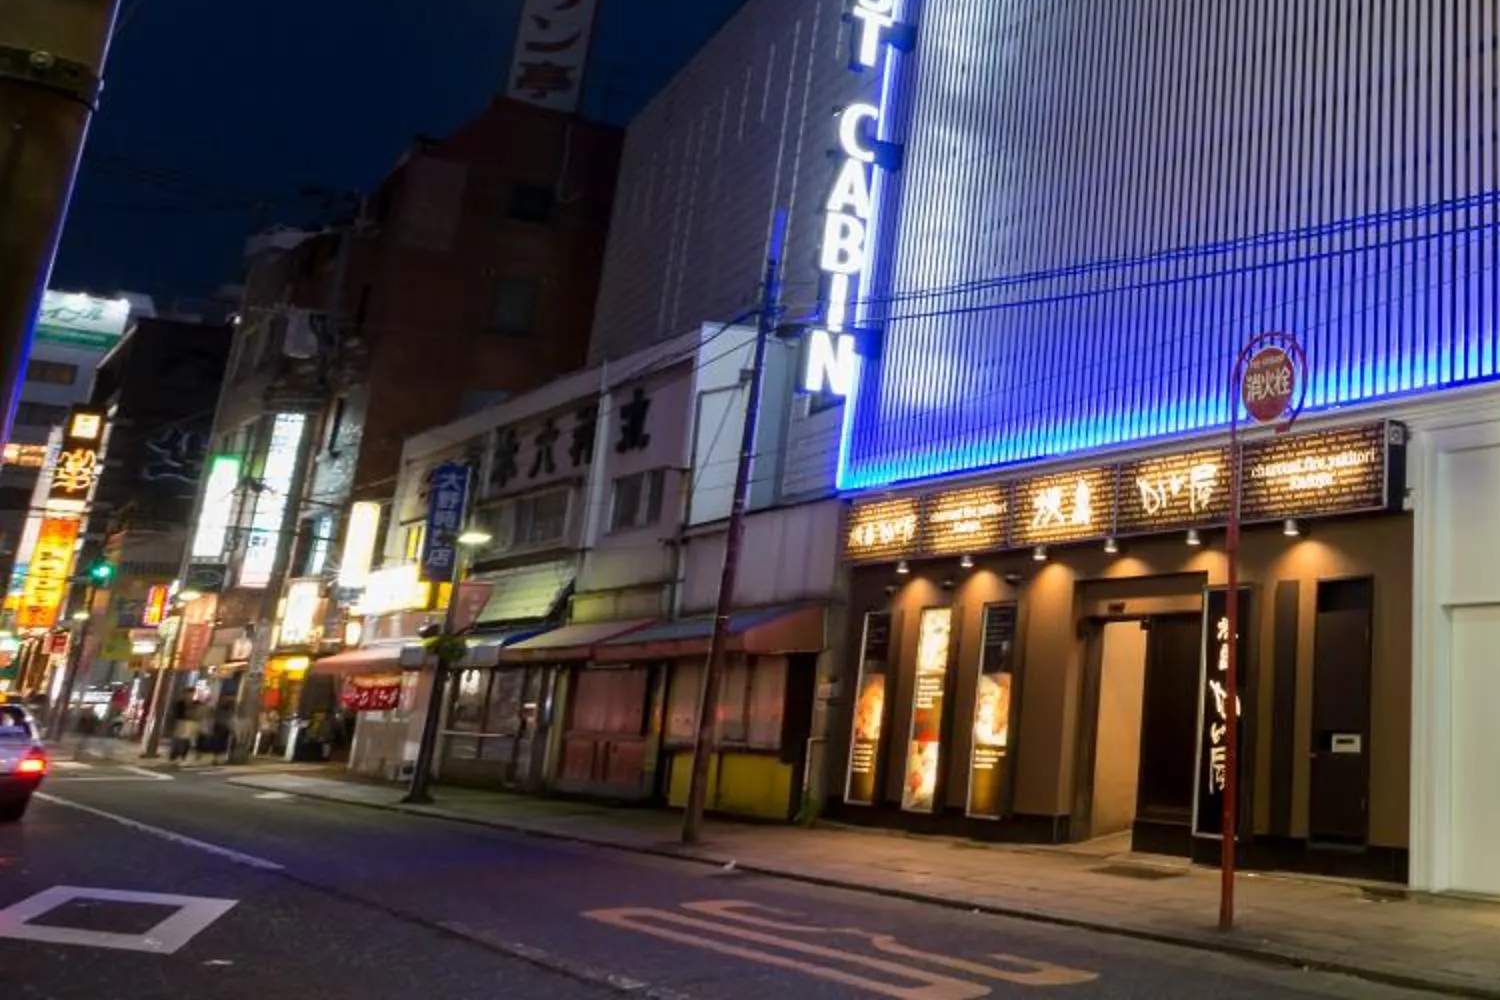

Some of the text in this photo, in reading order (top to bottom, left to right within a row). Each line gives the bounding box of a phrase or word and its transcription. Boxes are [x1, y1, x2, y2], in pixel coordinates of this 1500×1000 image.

[804, 102, 880, 397] CABIN
[1246, 367, 1291, 402] 消火栓
